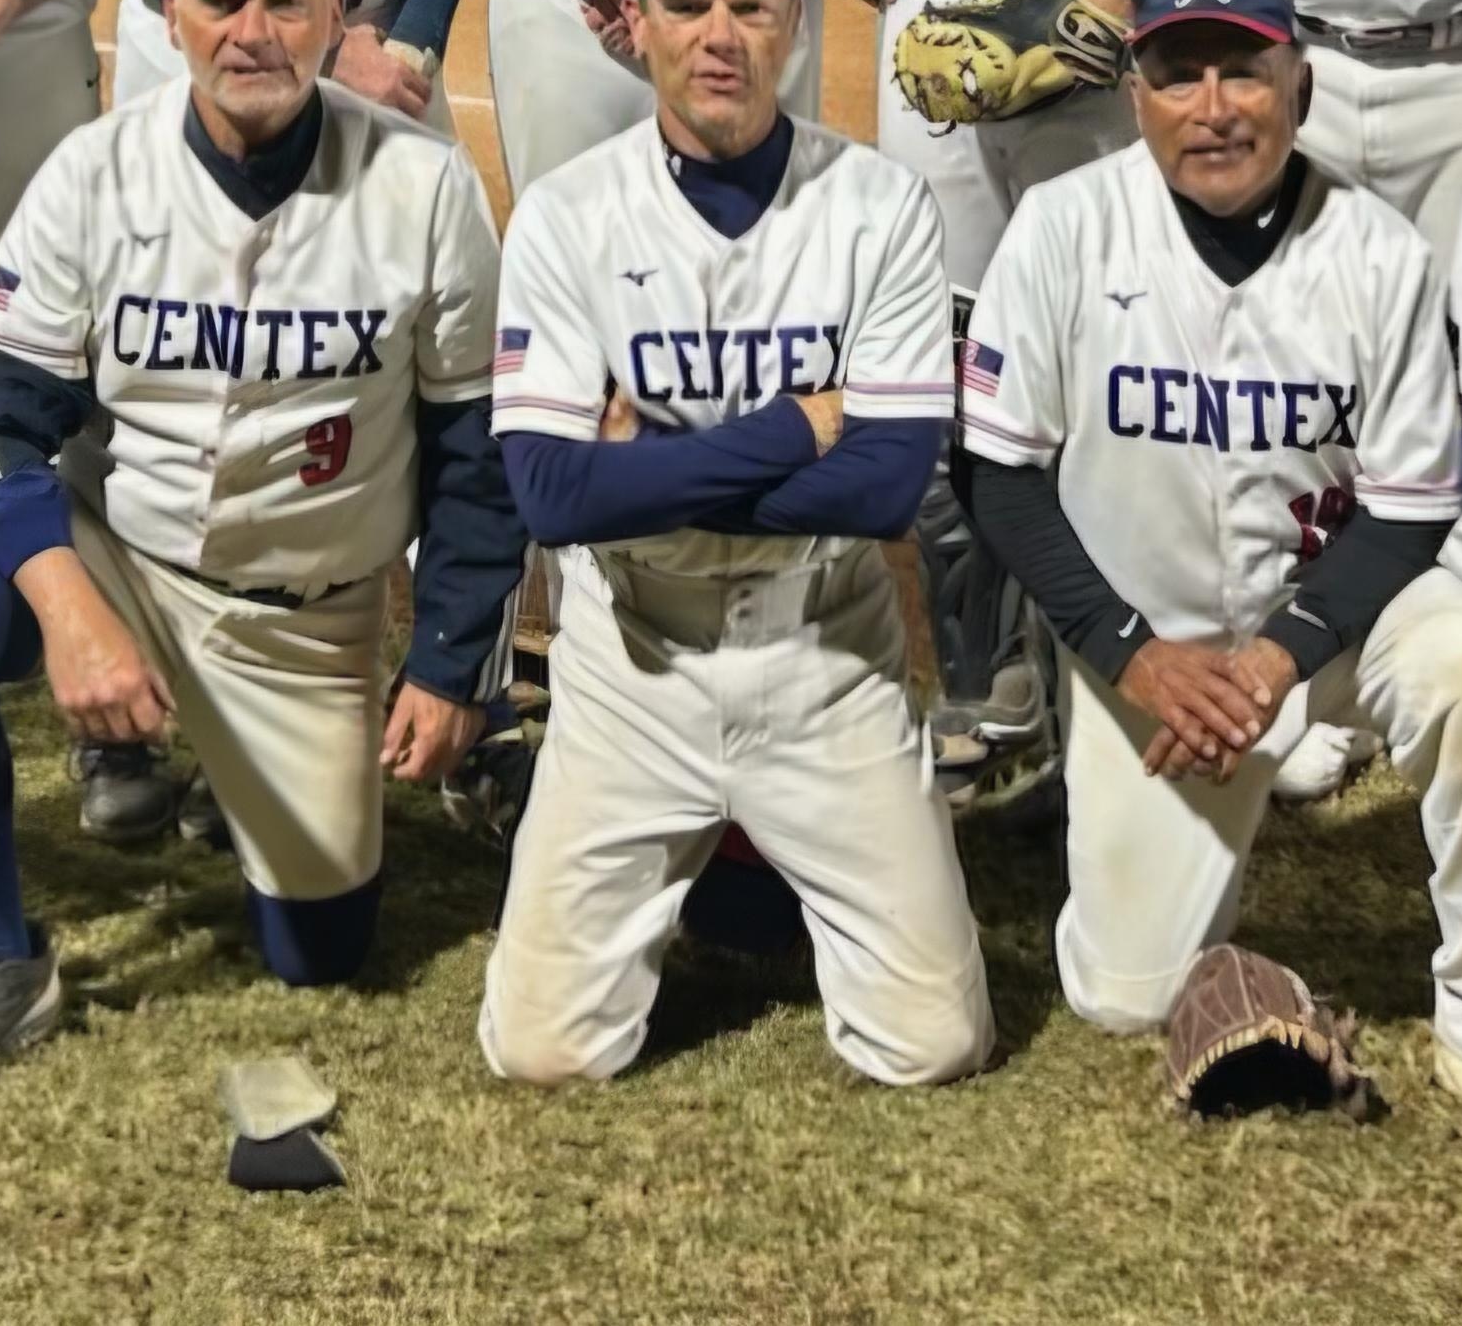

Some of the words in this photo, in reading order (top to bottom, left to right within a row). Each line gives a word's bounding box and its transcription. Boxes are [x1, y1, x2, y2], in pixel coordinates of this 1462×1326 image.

[113, 294, 388, 385] CENTEX
[297, 412, 353, 487] 9
[1107, 364, 1358, 453] CENTEX
